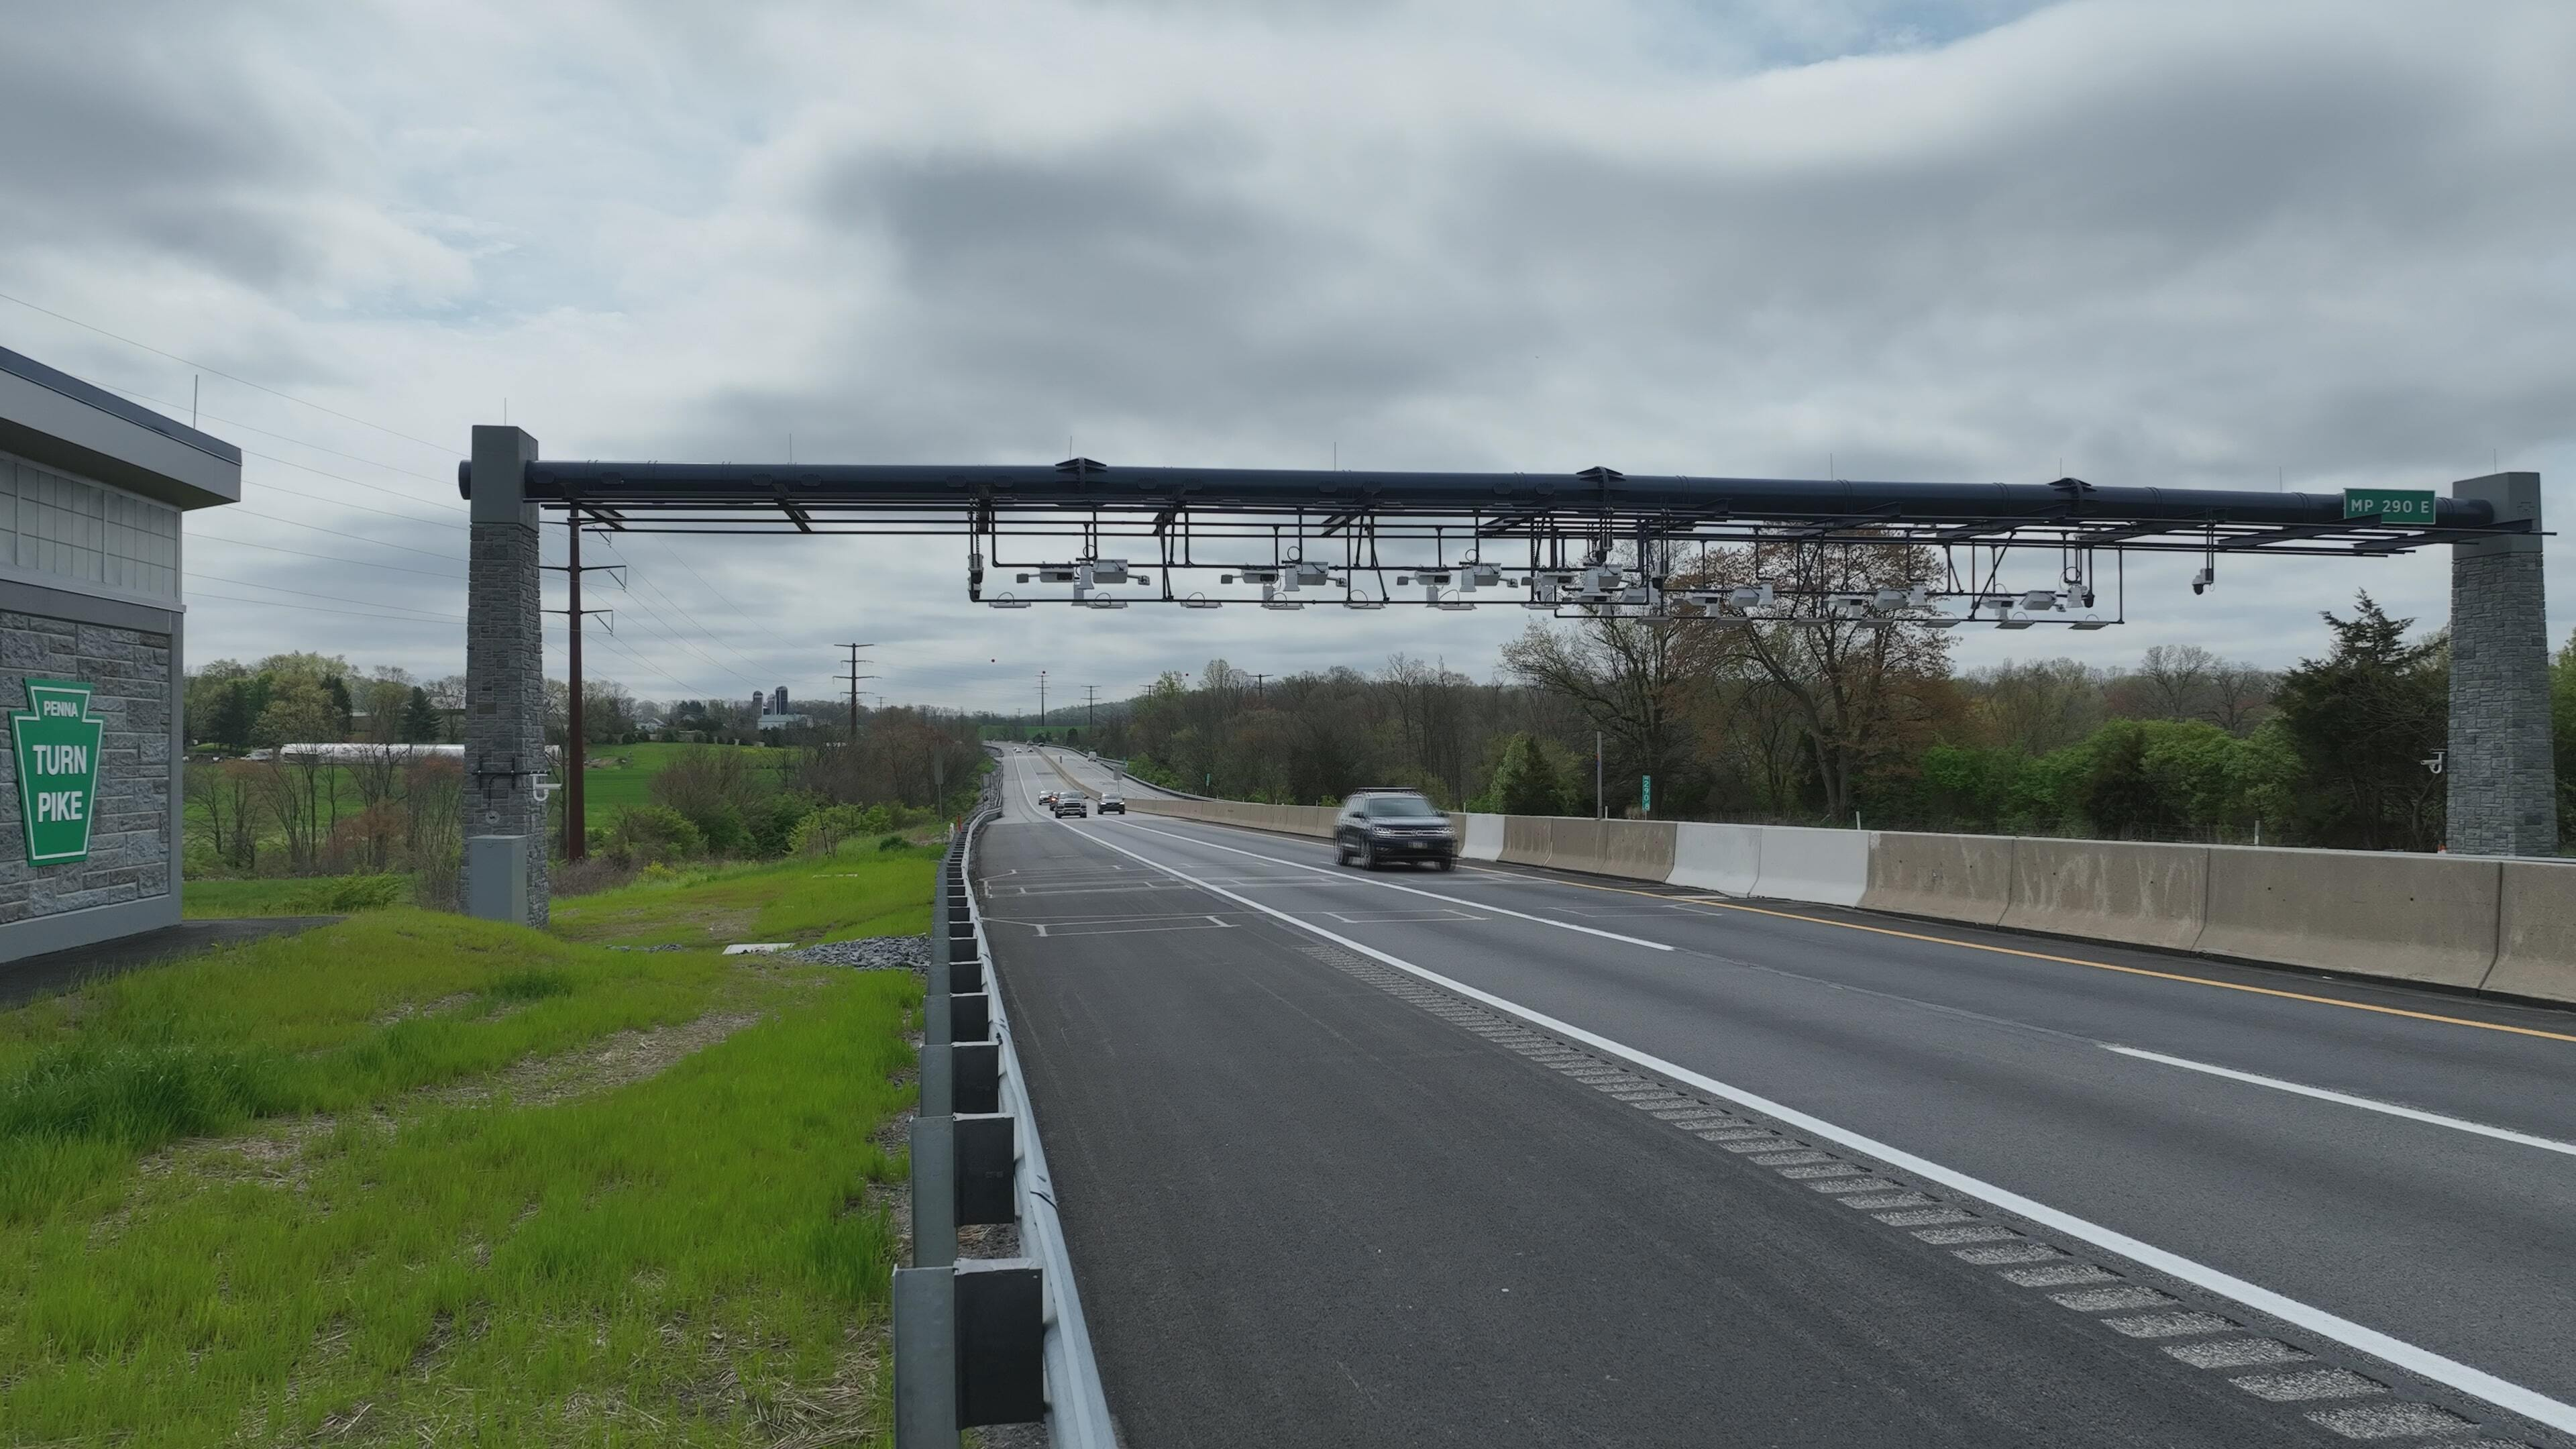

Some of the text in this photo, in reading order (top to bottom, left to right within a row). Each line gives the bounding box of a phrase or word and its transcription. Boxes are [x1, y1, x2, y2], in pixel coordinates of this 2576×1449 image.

[2351, 498, 2429, 513] MP 290 E
[44, 700, 78, 718] PENNA
[33, 745, 87, 775] TURN
[38, 791, 83, 822] PIKE
